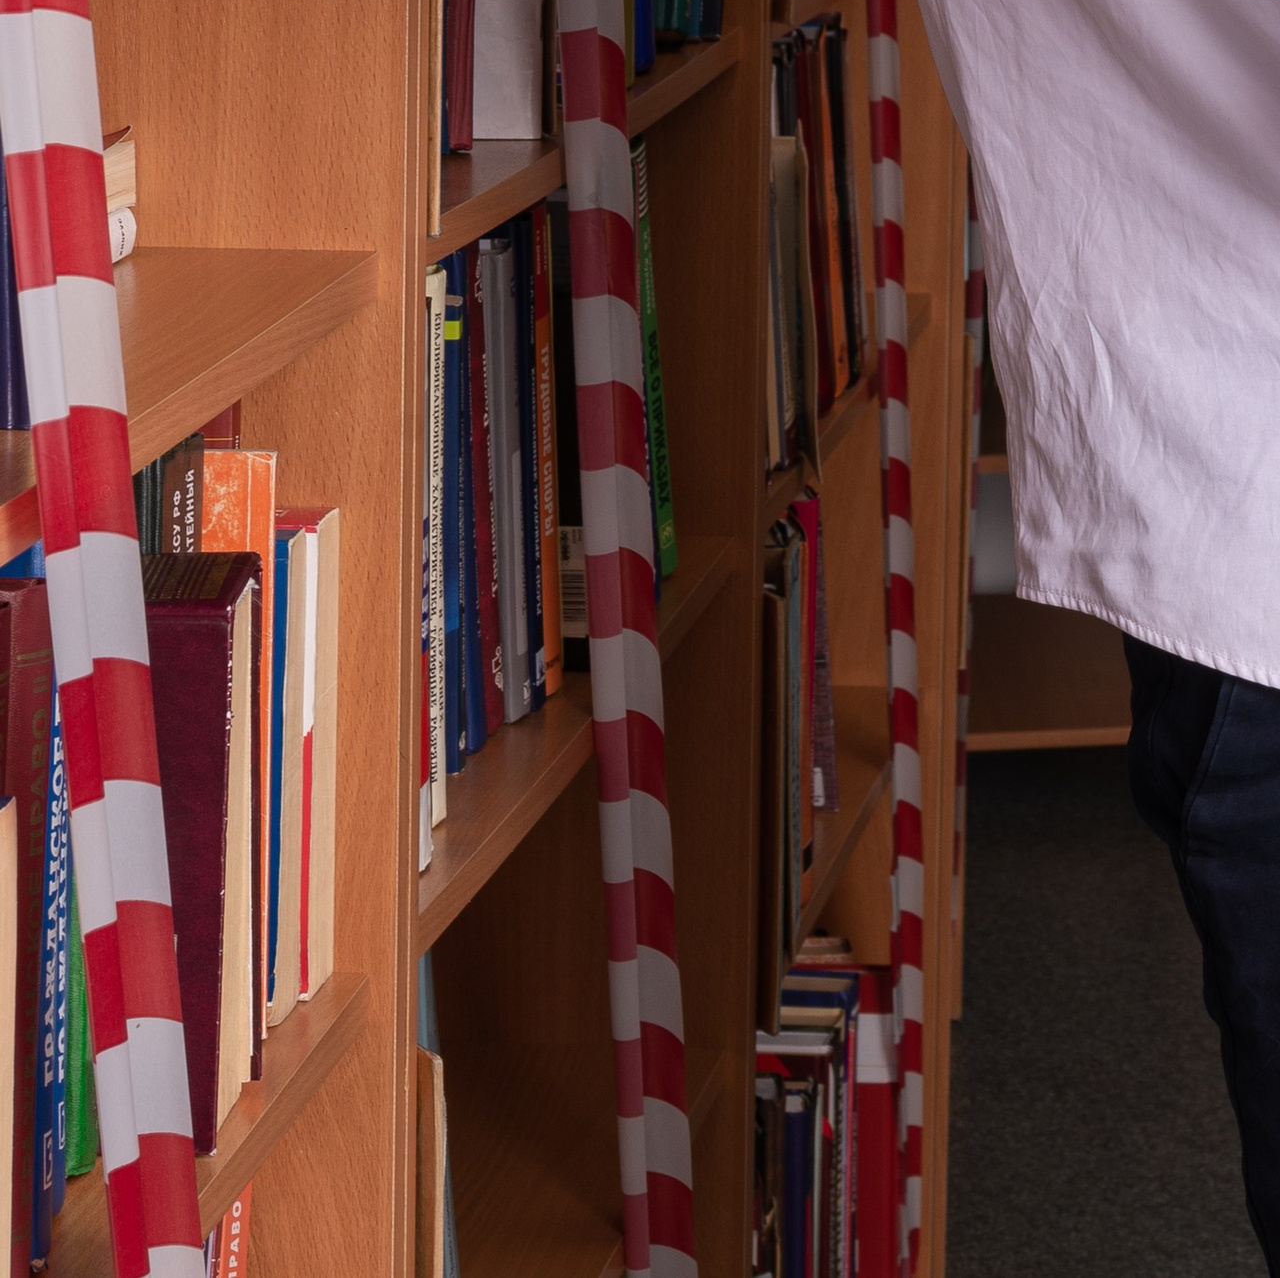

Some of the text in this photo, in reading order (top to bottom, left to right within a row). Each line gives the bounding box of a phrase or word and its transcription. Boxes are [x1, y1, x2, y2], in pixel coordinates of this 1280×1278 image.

[431, 311, 441, 478] КВАЛИФИКАЦИОННЫЕ
[647, 329, 659, 375] ВСЕ
[172, 489, 181, 518] РФ
[539, 343, 554, 535] ТРУДОВЫЕ СПОРЫ
[652, 395, 670, 509] ПРИКАЗАХ
[43, 735, 64, 1087] ГРАЖДАНСКОЕ
